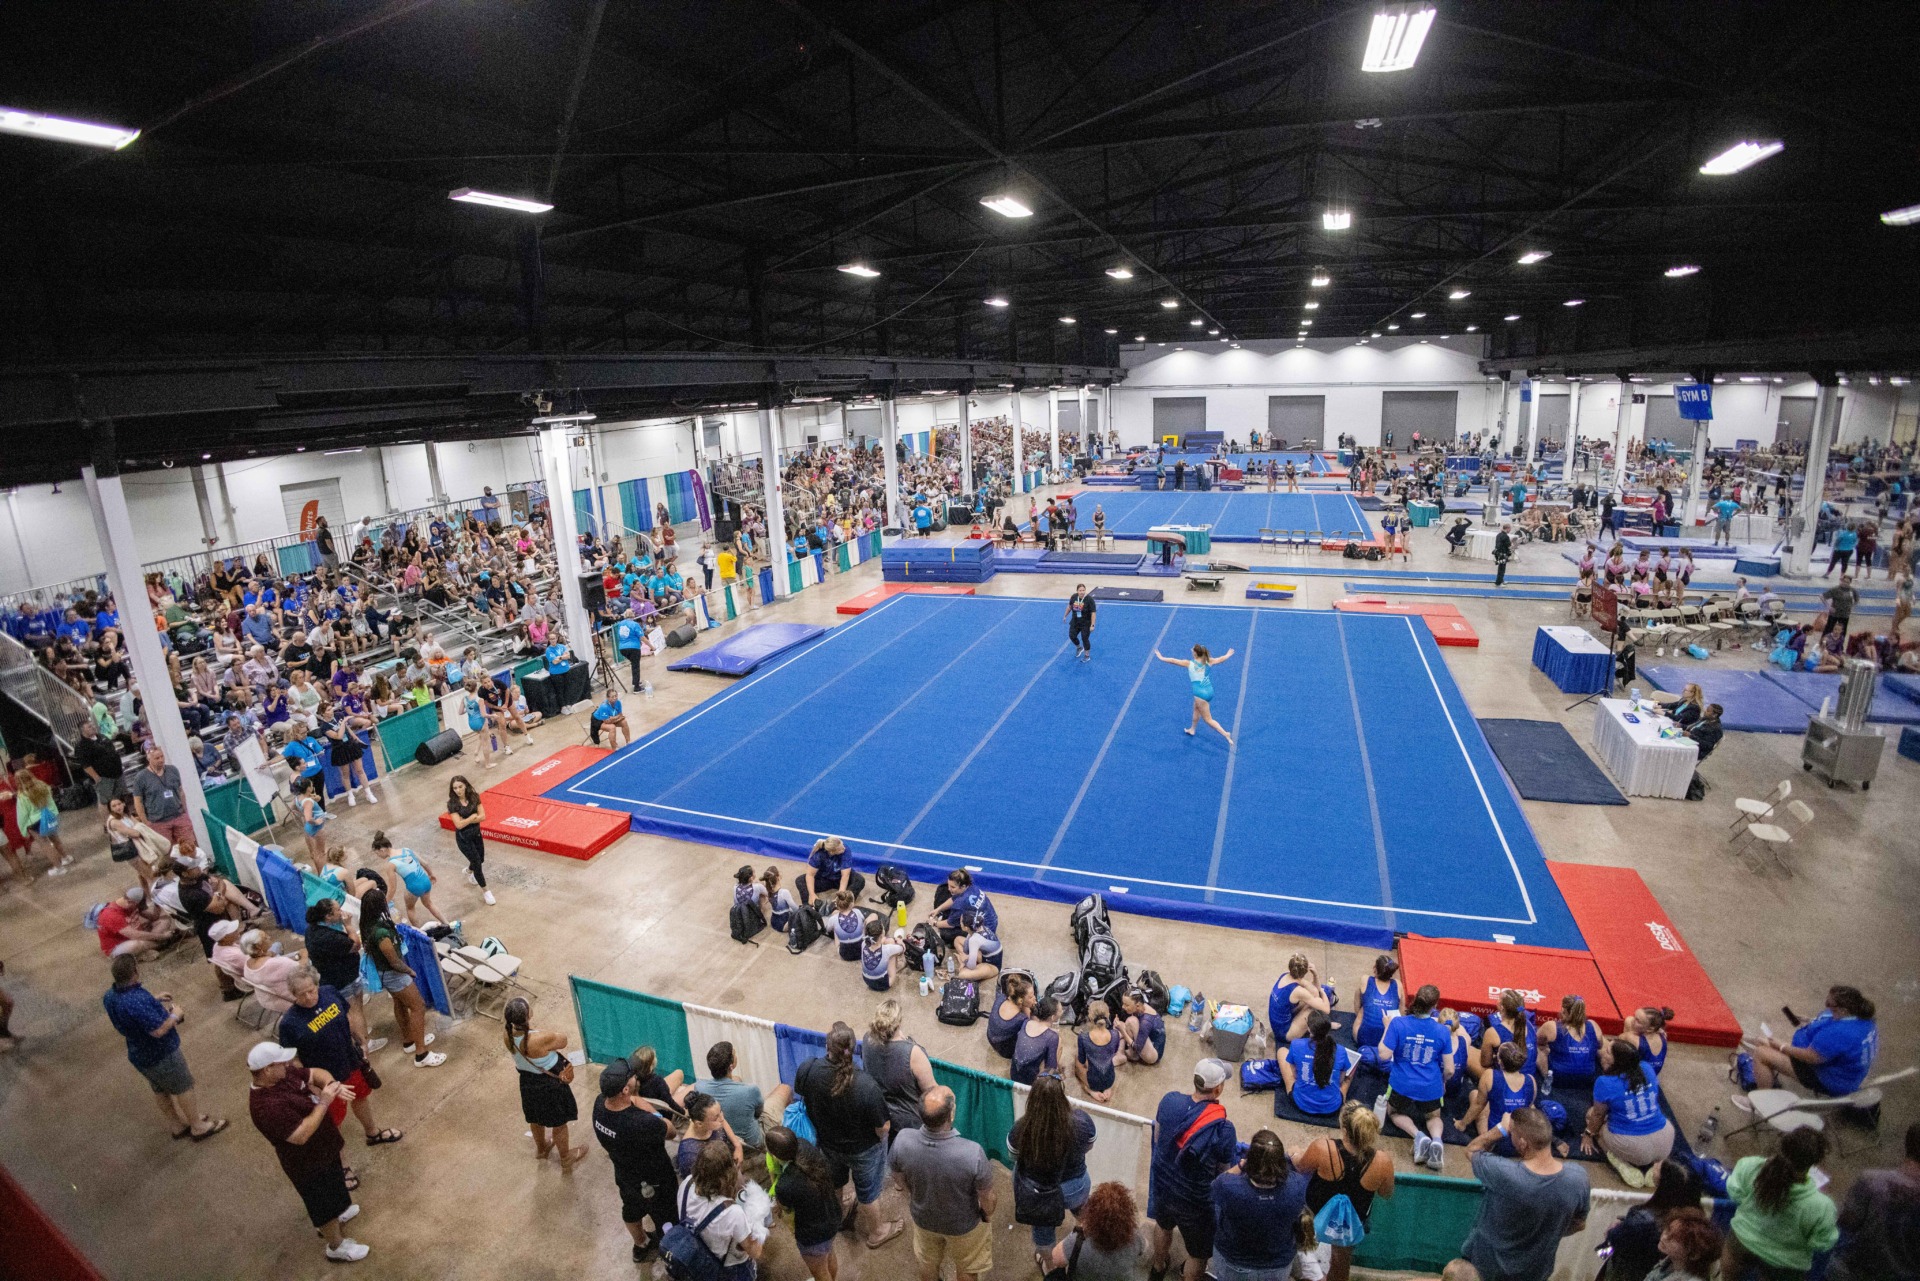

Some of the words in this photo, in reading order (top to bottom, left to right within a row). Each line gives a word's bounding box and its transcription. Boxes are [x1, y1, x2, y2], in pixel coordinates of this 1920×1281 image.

[1681, 390, 1699, 402] GYM
[1701, 389, 1708, 401] B
[1649, 927, 1675, 951] DGS
[307, 1003, 341, 1033] WARNER
[595, 1120, 617, 1139] ECKERT
